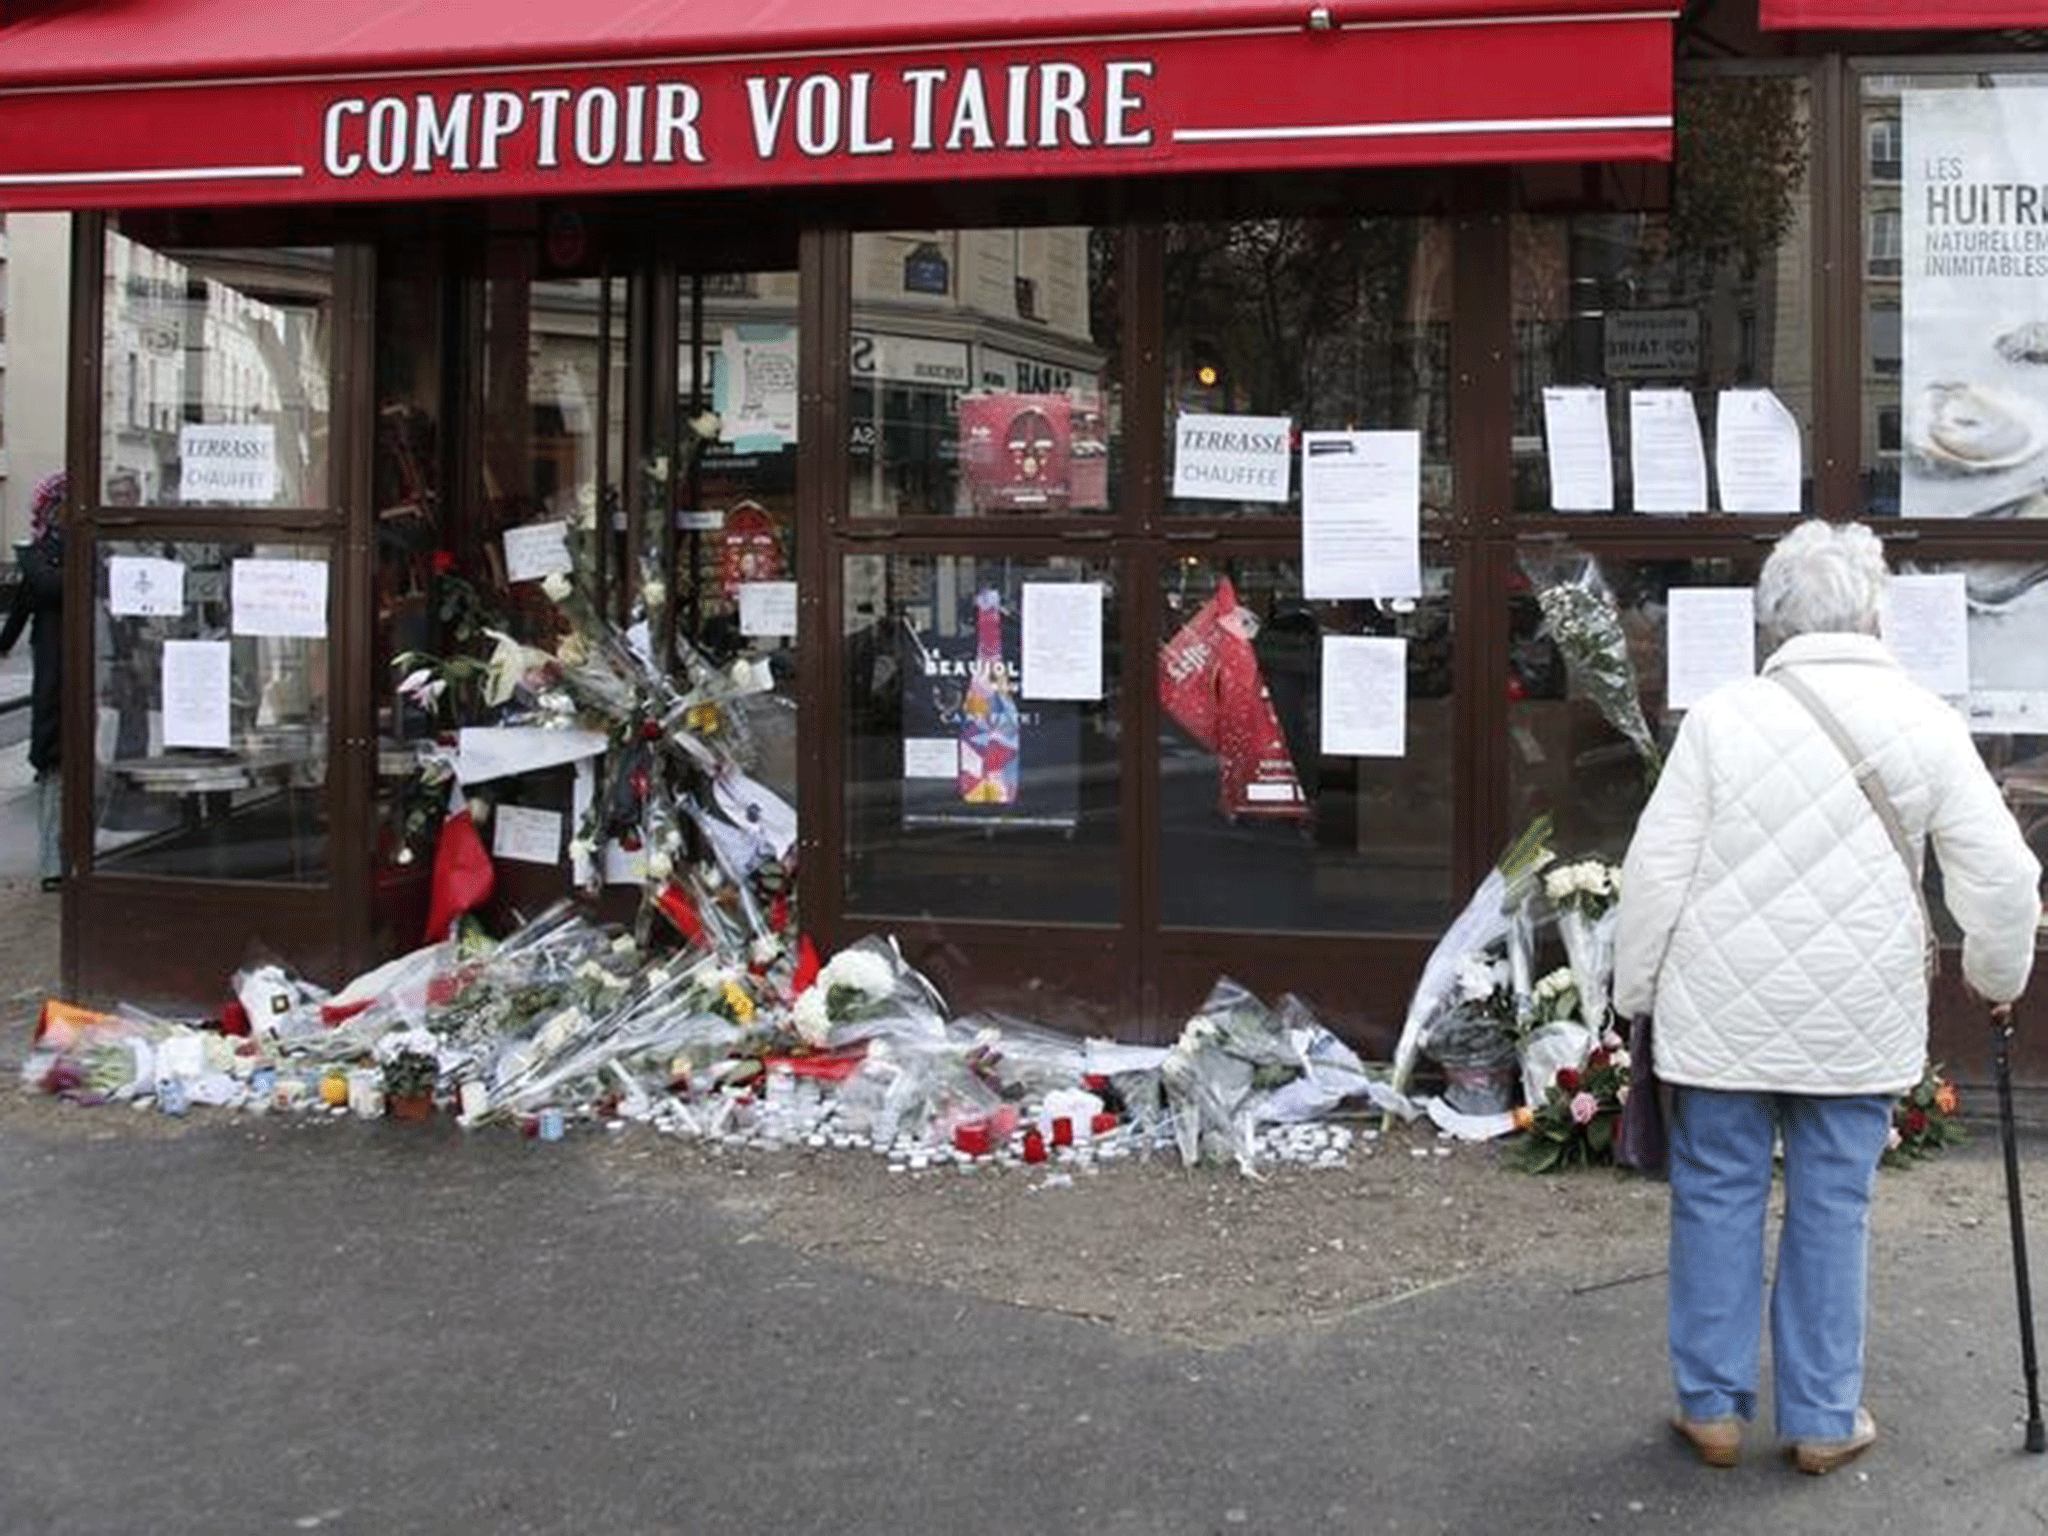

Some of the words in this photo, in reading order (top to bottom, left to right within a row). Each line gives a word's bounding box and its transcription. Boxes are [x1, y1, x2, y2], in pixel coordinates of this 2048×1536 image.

[323, 83, 706, 177] COMPTOIR
[745, 61, 1154, 158] VOLTAIRE
[1924, 157, 1962, 181] LES
[1924, 255, 2048, 277] INIMITABLES
[185, 439, 267, 459] TERRASSE
[1182, 430, 1286, 455] TERRASSE
[1182, 463, 1279, 487] CHAUFFEE
